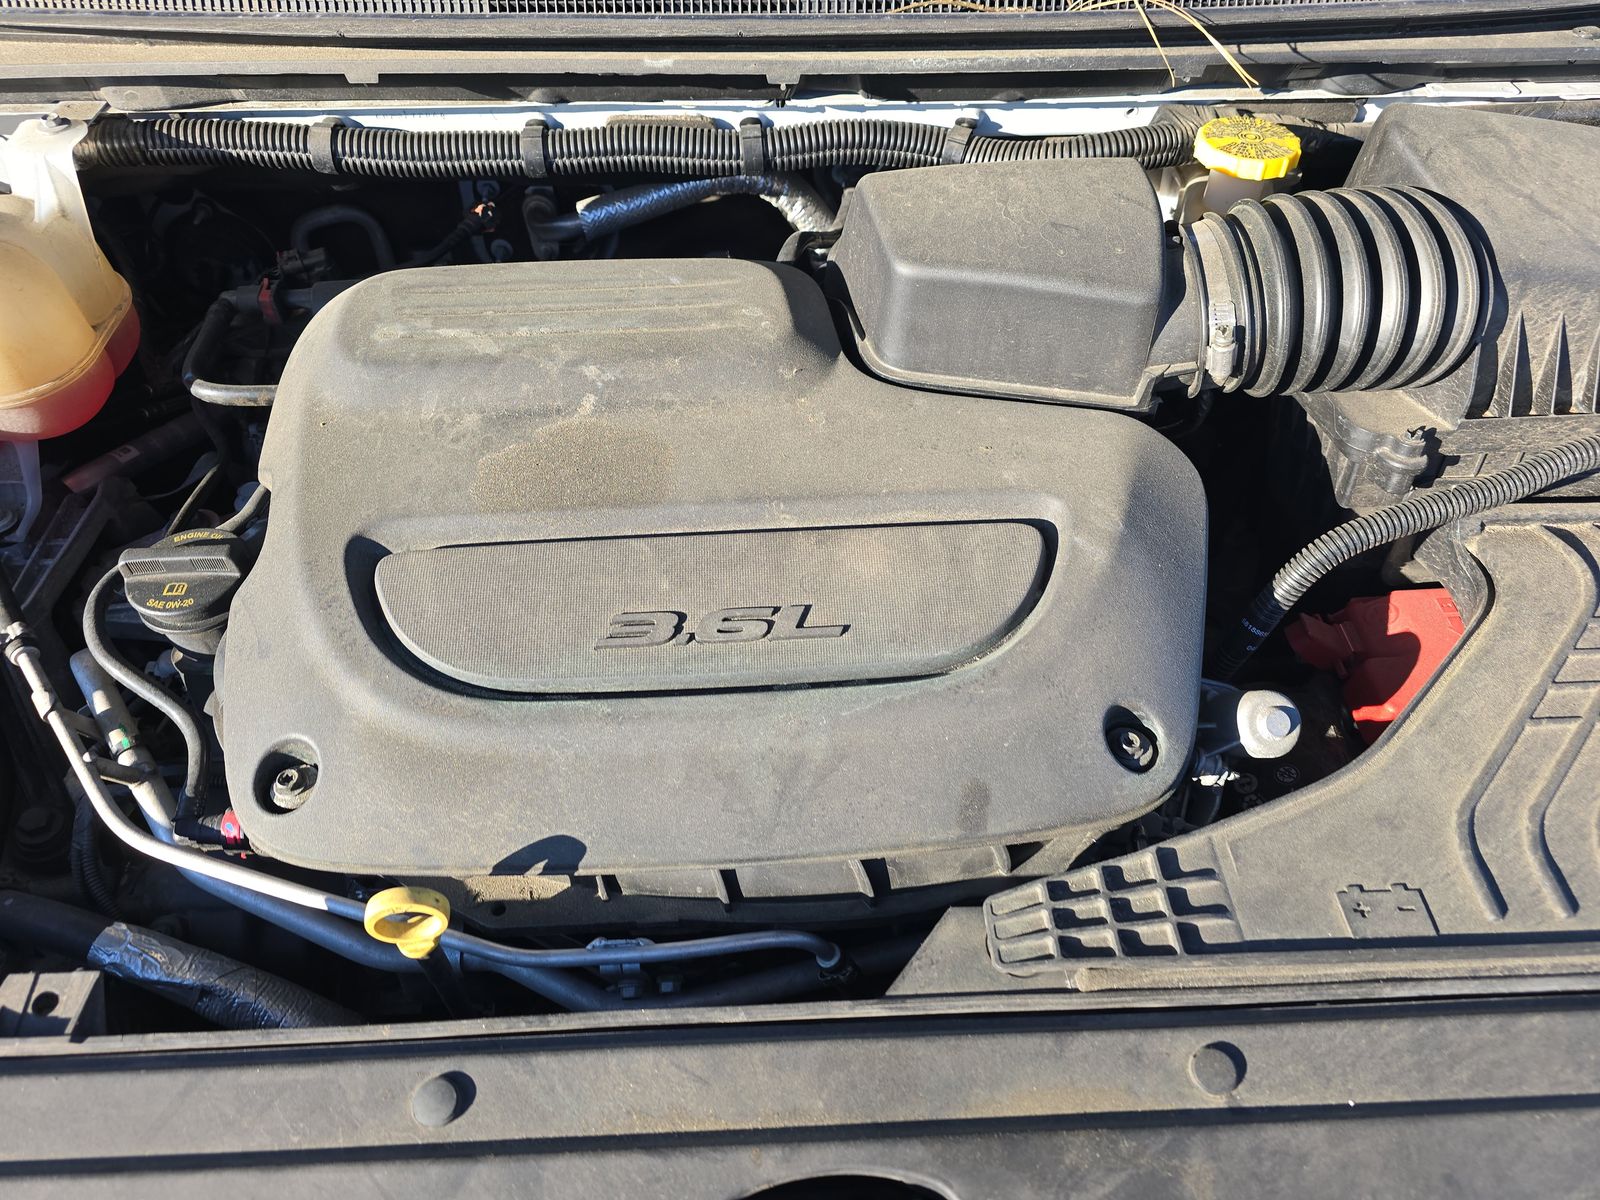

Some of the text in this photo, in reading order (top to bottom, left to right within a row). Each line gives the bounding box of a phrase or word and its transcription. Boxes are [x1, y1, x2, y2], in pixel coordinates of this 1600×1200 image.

[174, 531, 208, 542] ENGINE
[146, 598, 194, 608] SAE 0W-20
[594, 604, 852, 651] 3.6L
